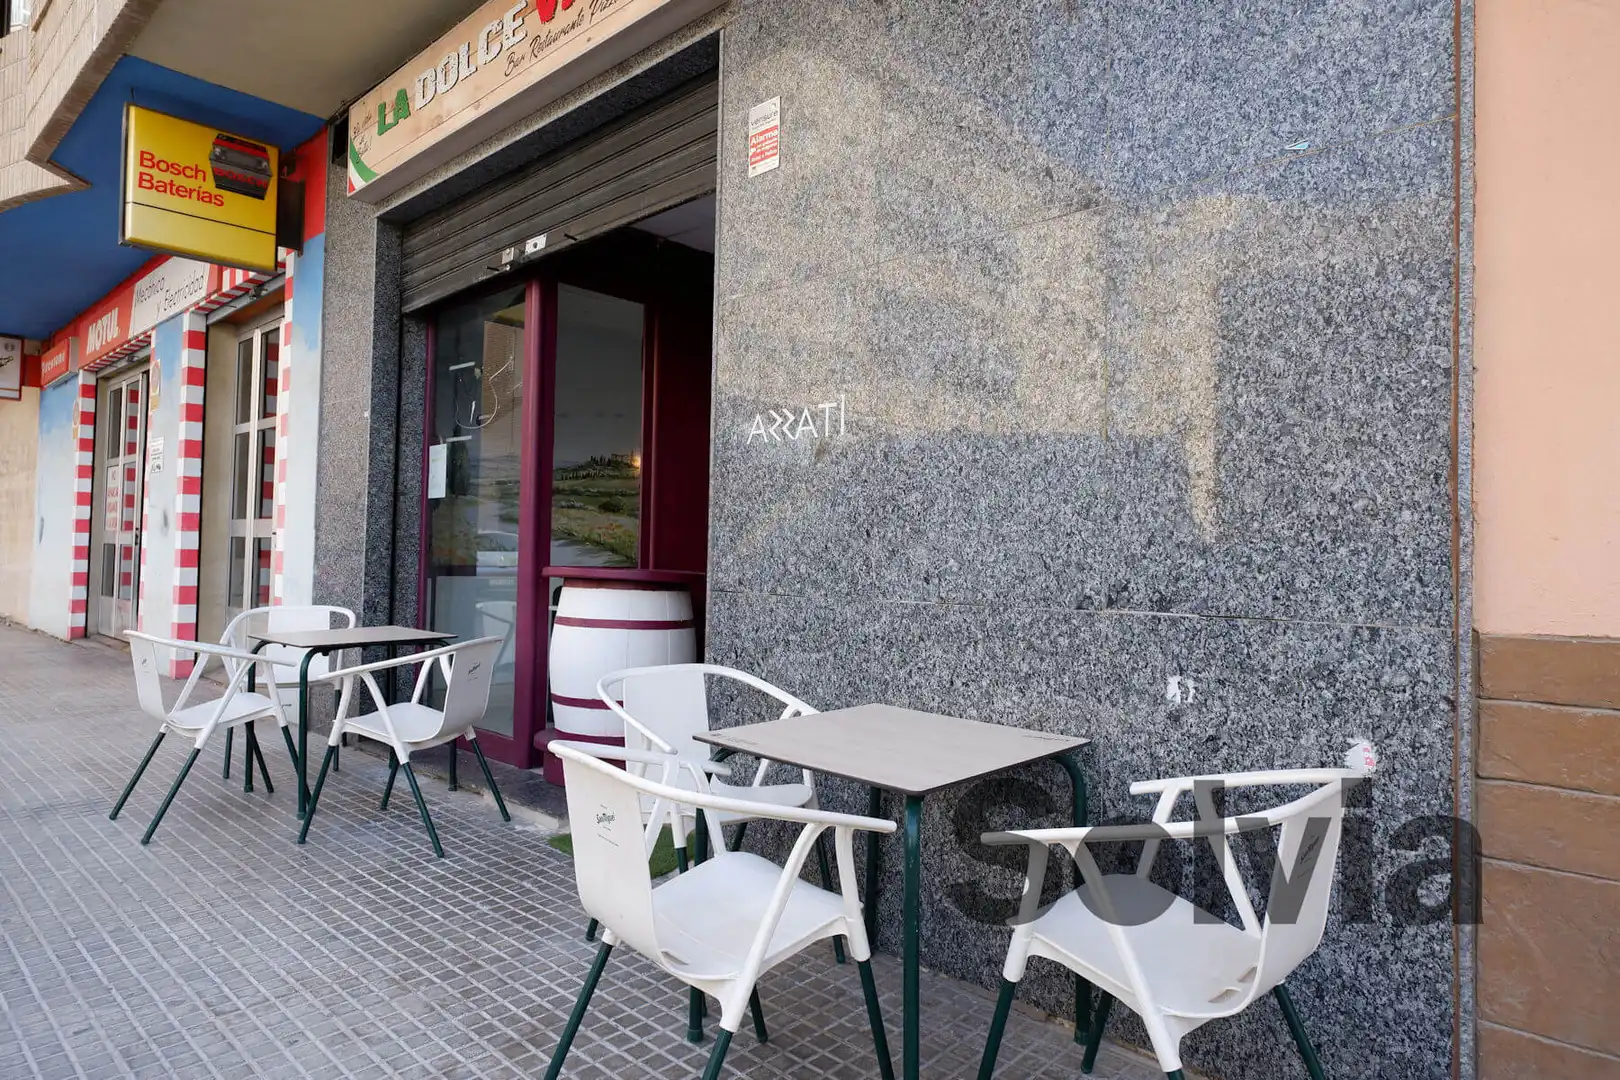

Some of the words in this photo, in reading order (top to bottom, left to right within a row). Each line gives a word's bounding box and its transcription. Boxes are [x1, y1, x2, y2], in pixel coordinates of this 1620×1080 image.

[504, 51, 526, 77] Bar
[529, 10, 585, 62] Restaurante
[377, 88, 411, 136] LA
[414, 0, 529, 111] DOLCE
[751, 129, 778, 145] Alarma
[139, 150, 206, 182] Bosch
[213, 166, 268, 189] BOSCH
[138, 171, 224, 207] Baterías
[86, 307, 119, 356] MOTUL
